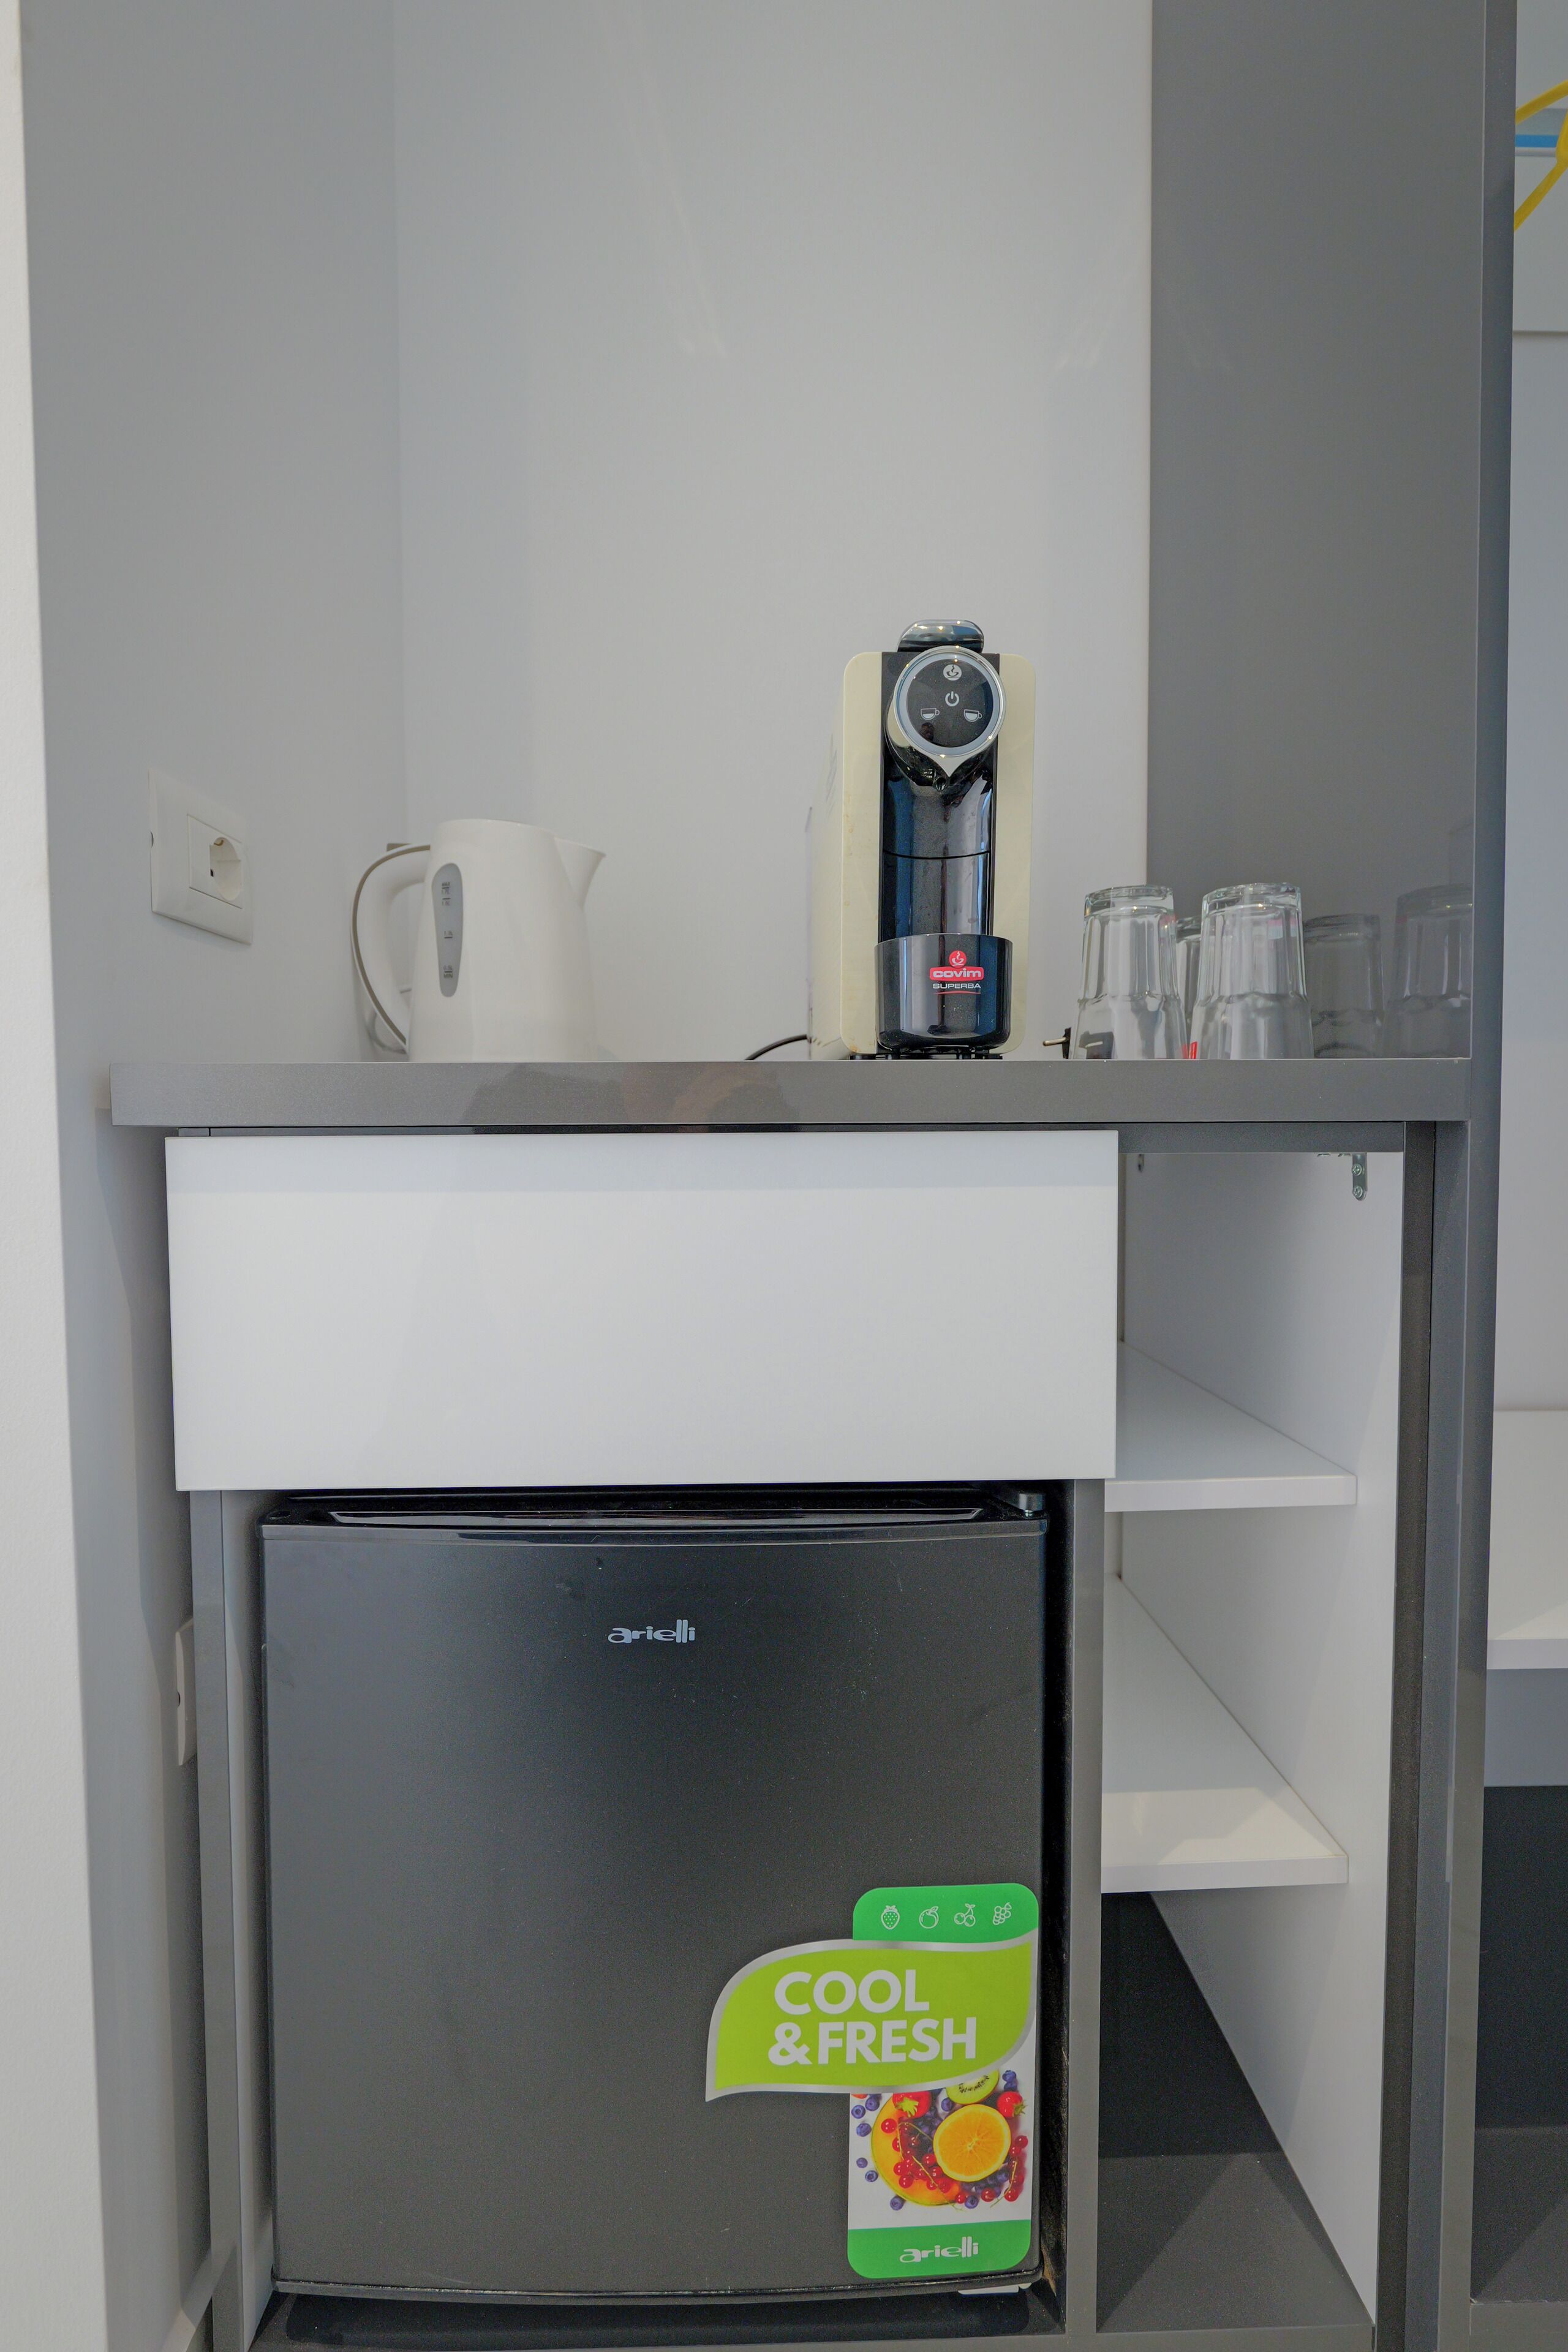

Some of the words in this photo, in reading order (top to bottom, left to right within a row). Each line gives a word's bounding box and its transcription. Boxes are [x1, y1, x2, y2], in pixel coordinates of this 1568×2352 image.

[932, 968, 981, 978] covim
[608, 1619, 696, 1643] arielli
[774, 1969, 930, 2015] COOL
[900, 2236, 979, 2263] arielli
